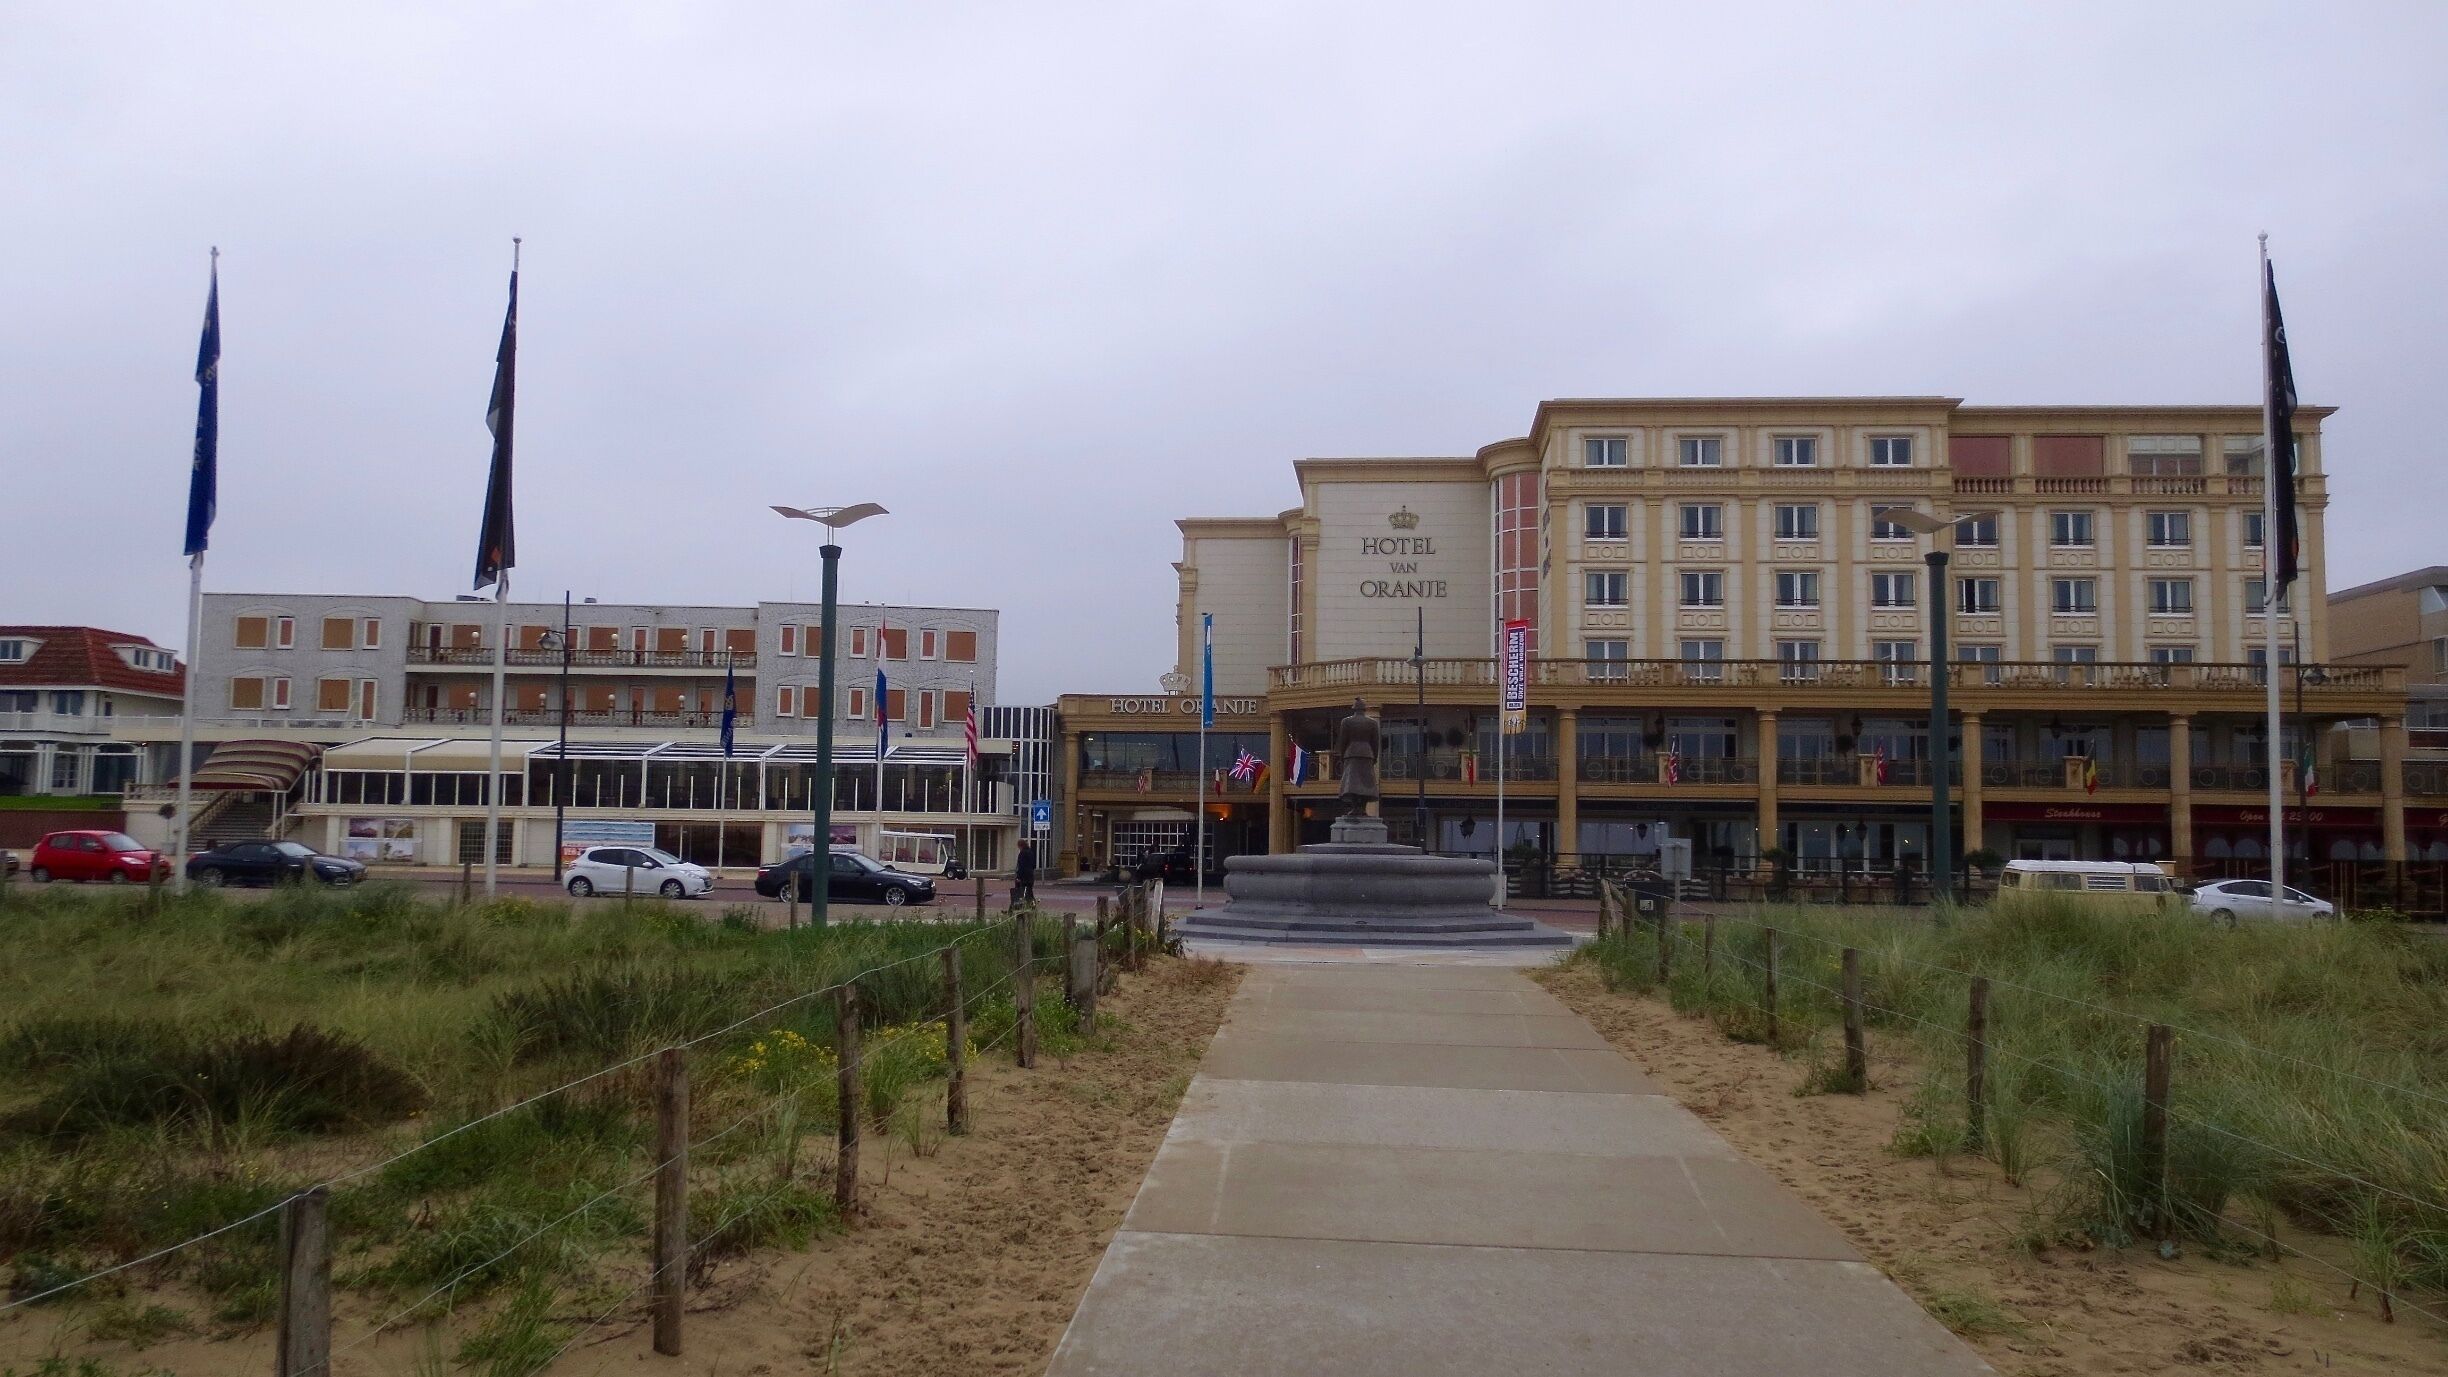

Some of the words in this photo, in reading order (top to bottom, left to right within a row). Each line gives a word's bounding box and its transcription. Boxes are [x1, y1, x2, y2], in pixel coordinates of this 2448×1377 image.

[1361, 537, 1436, 555] HOTEL
[1389, 562, 1418, 574] VAN
[1360, 580, 1448, 598] ORANJE
[1507, 631, 1518, 700] BESCHERM
[1110, 698, 1171, 714] HOTEL
